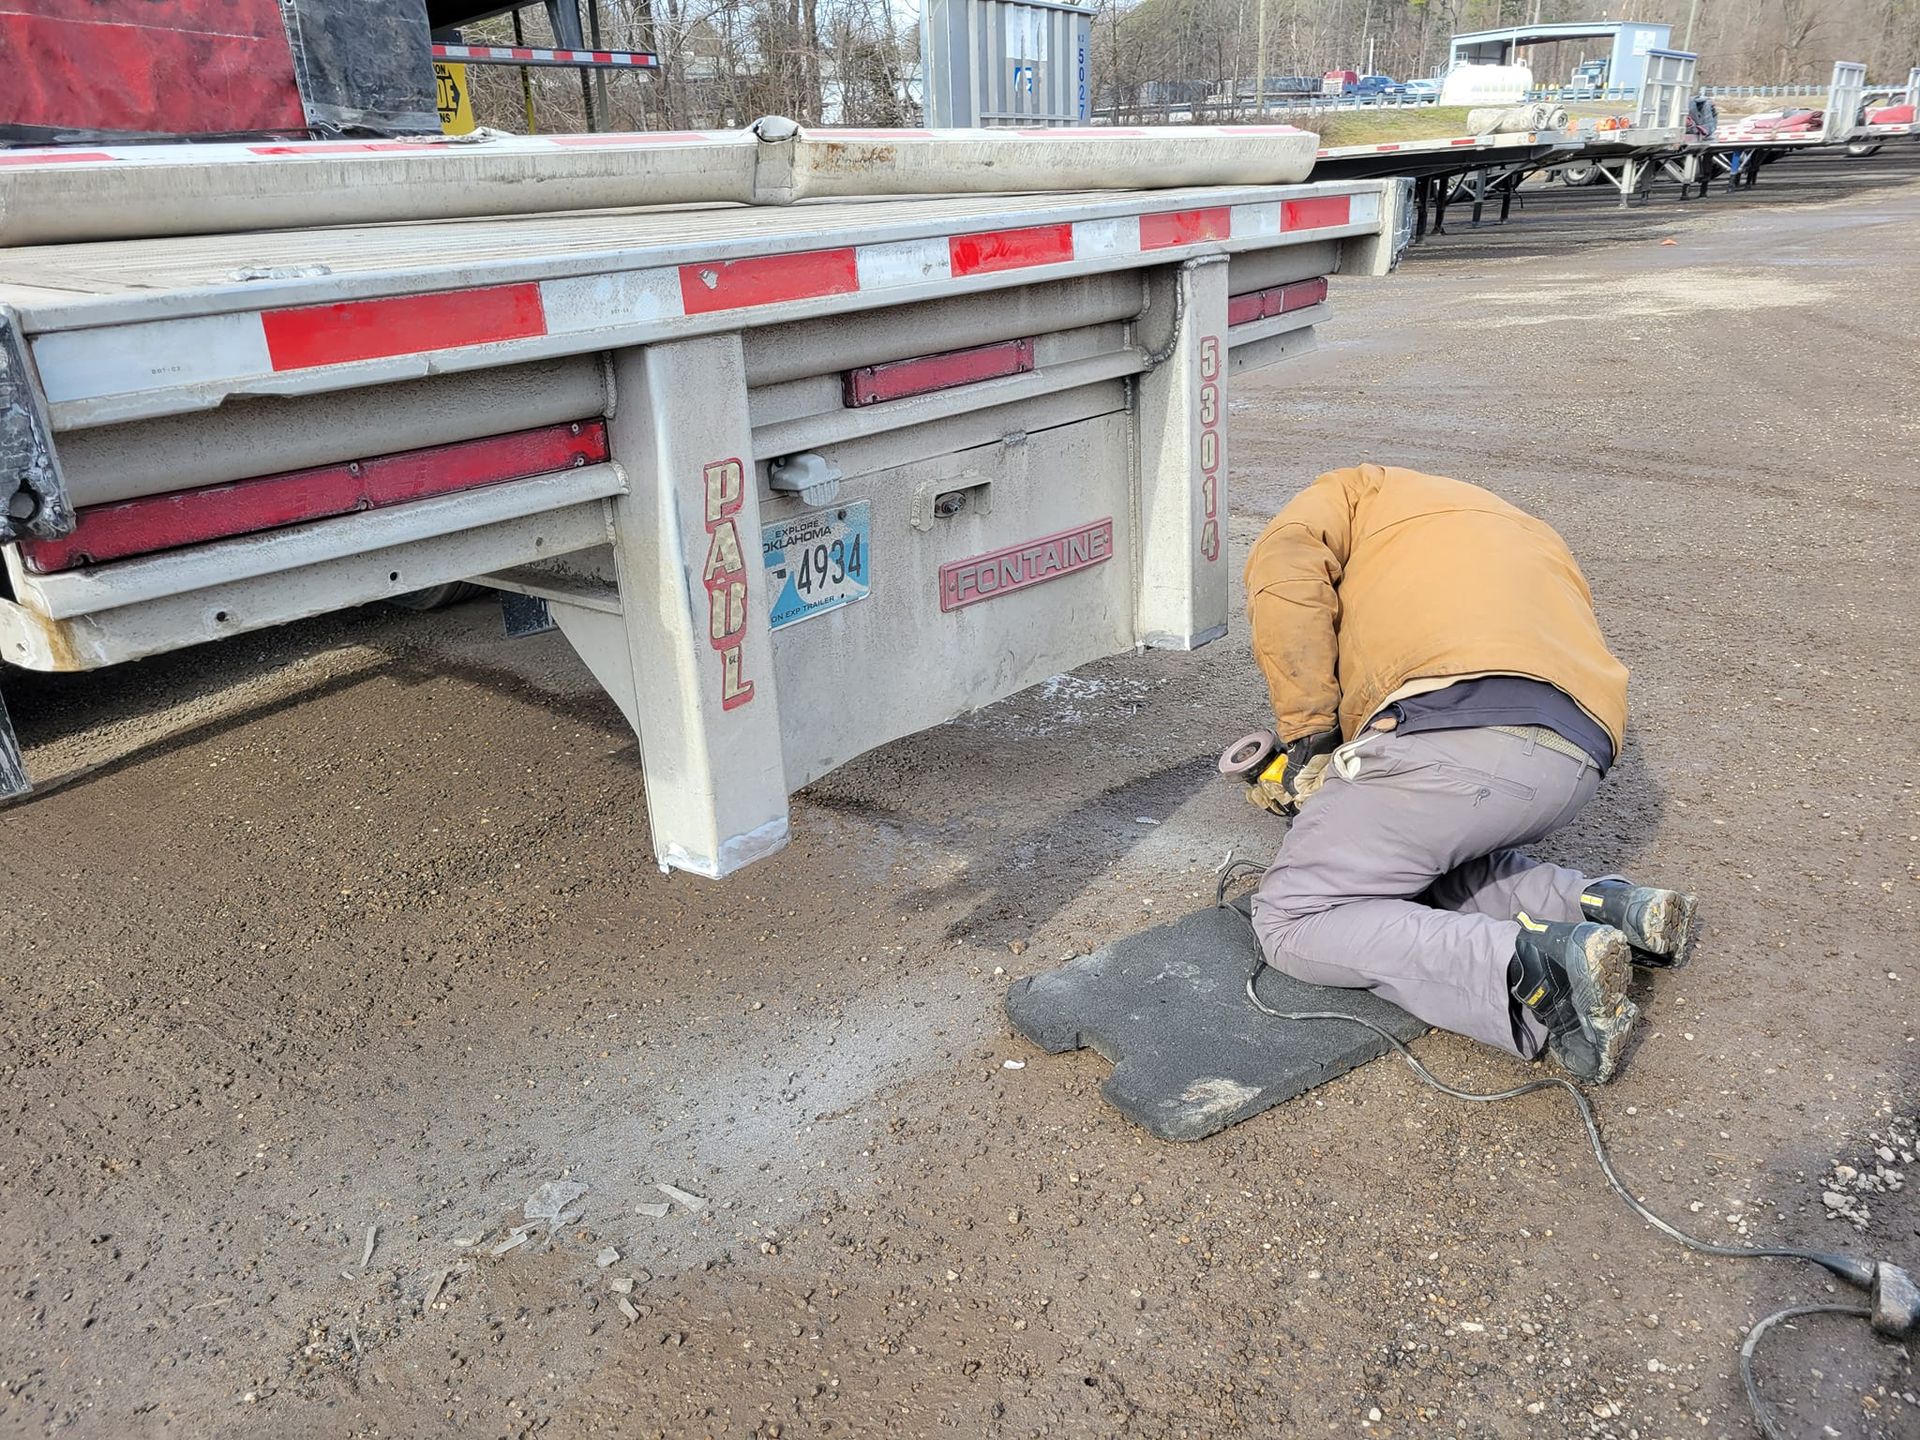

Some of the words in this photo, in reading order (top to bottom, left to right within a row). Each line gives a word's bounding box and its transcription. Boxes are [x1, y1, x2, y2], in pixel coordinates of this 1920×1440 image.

[433, 63, 446, 75] ON
[1078, 47, 1086, 121] 5027
[1201, 335, 1220, 562] 53014
[775, 519, 820, 538] EXPLORE
[703, 457, 755, 710] PAUL
[797, 533, 862, 595] 4934
[957, 527, 1106, 600] FONTAINE
[785, 607, 801, 618] EXP
[802, 595, 835, 612] TRAILER
